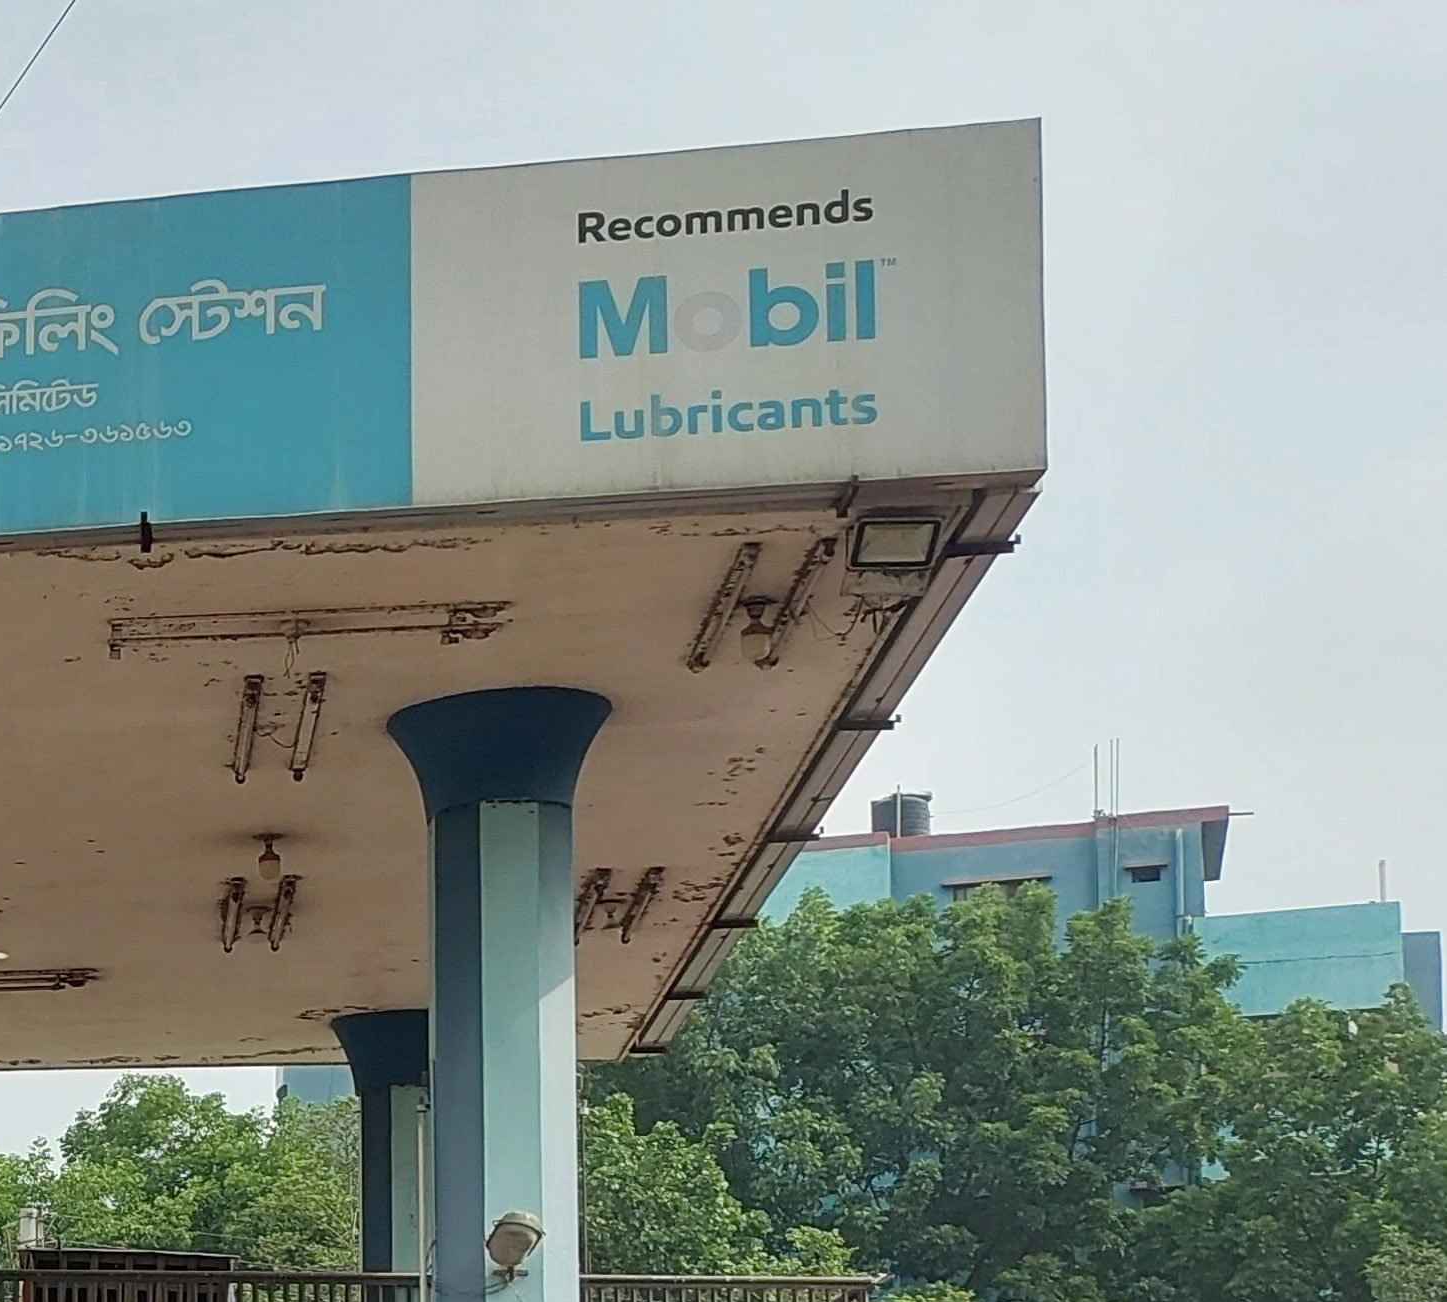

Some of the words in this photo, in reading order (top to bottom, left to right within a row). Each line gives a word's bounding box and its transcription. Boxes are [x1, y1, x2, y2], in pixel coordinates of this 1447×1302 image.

[577, 188, 874, 244] Recommends
[578, 259, 876, 359] Mobil
[579, 389, 879, 442] Lubricants
